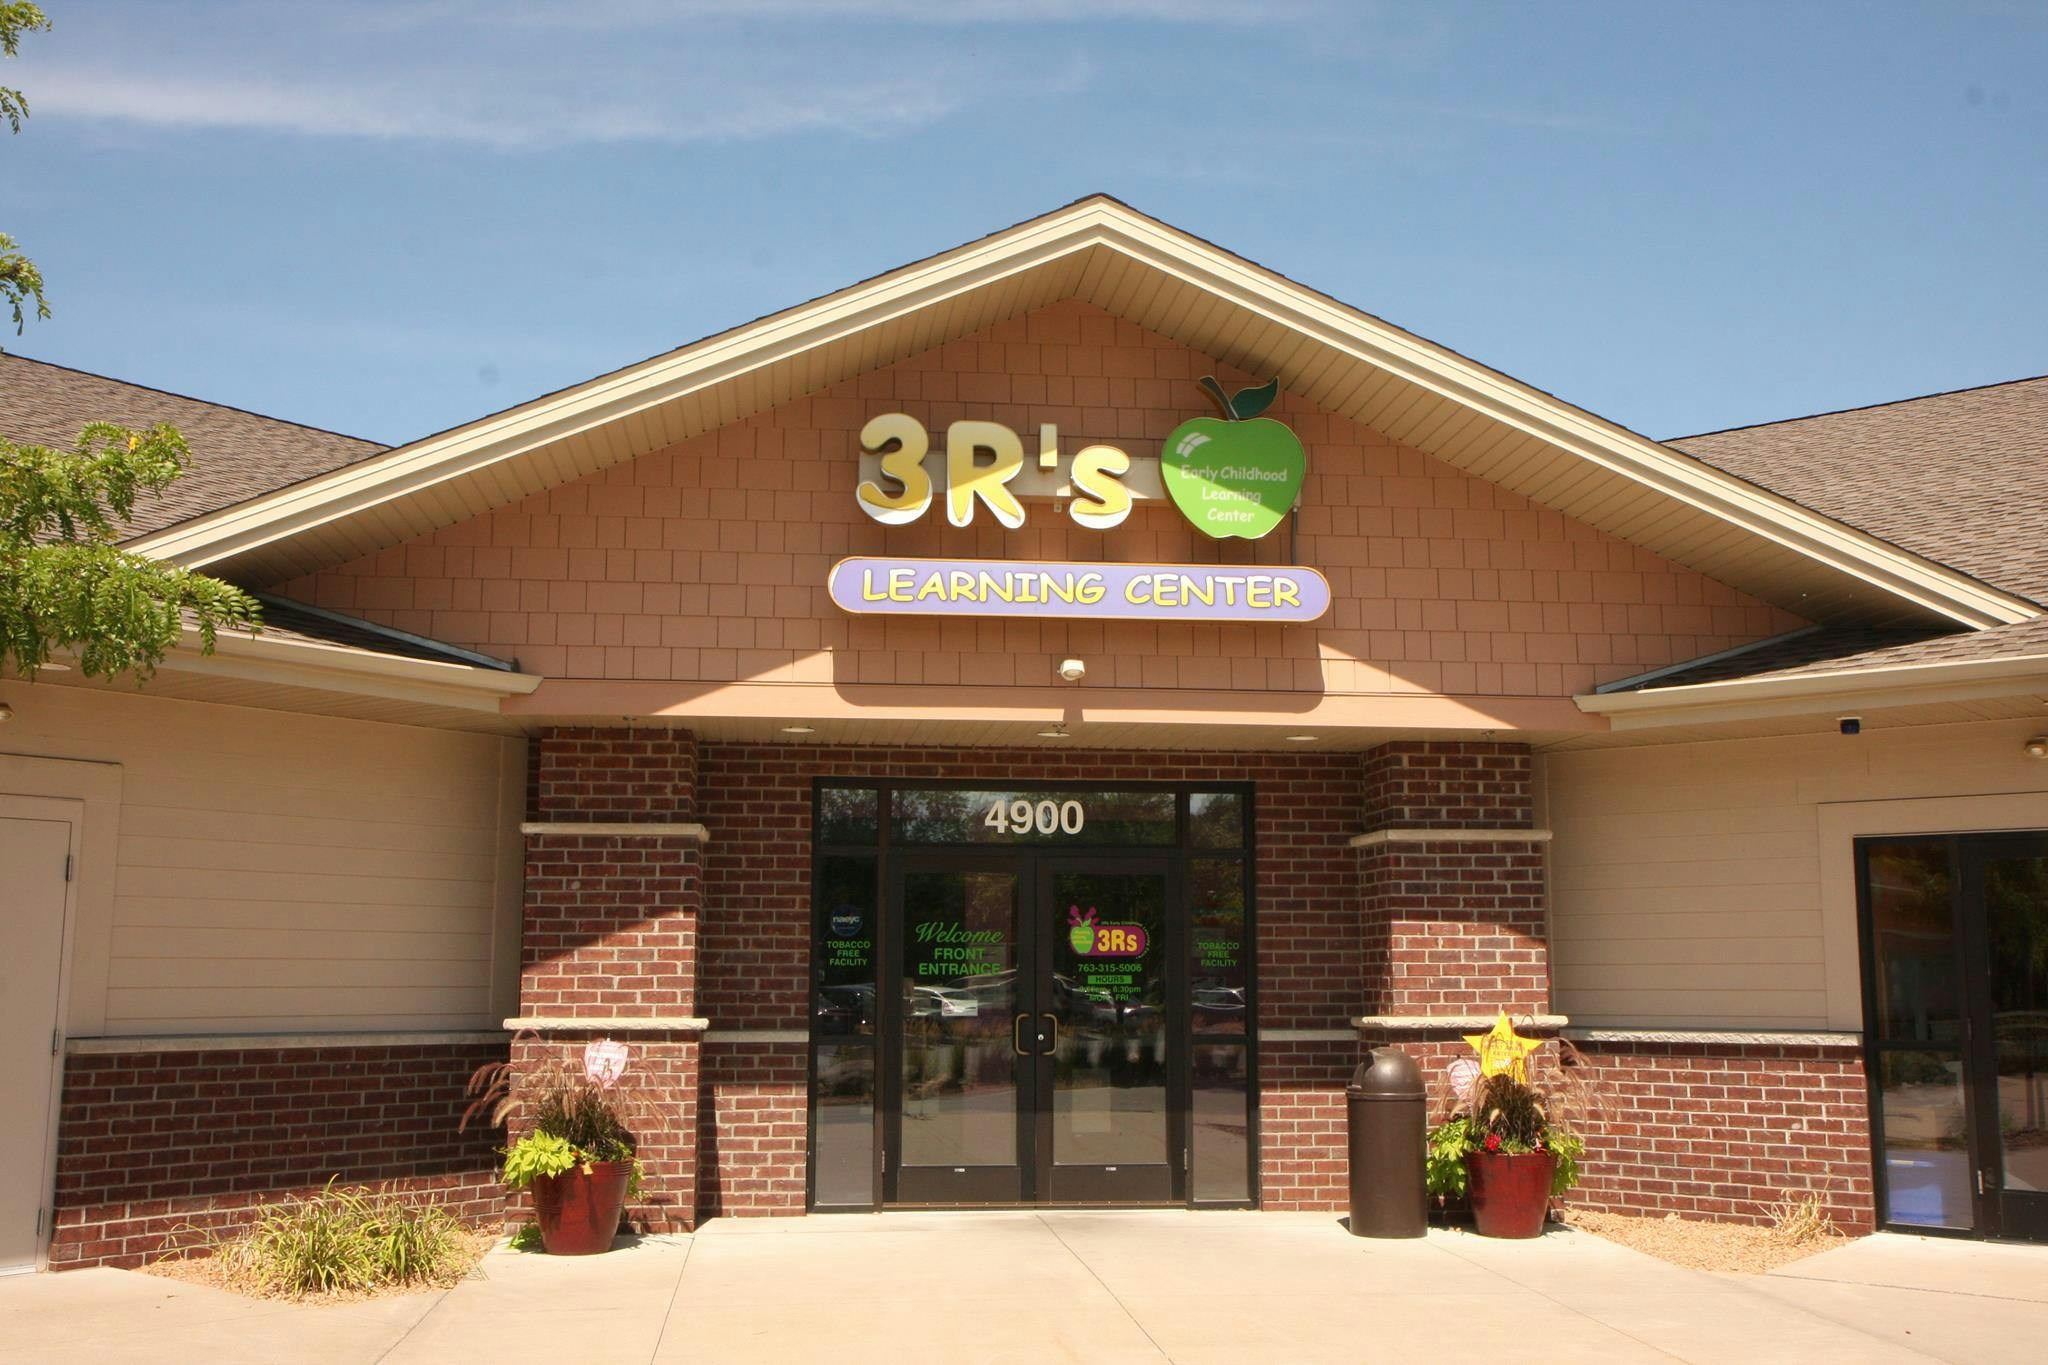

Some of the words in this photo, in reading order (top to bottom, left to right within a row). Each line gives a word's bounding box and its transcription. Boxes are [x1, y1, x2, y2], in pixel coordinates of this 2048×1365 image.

[1181, 464, 1218, 484] Early
[1220, 466, 1288, 482] Childhood
[1202, 486, 1261, 505] Learning
[1207, 508, 1255, 522] Center
[862, 568, 1106, 604] LEARNING
[1124, 573, 1301, 608] CENTER
[984, 799, 1084, 835] 4900
[915, 921, 1005, 943] Welcome
[827, 940, 871, 949] TOBACCO
[1097, 929, 1138, 952] 3Rs
[1198, 942, 1240, 950] TOBACCO
[836, 949, 860, 957] FREE
[934, 947, 986, 960] FRONT
[1207, 950, 1230, 958] FREE
[829, 958, 868, 966] FACILITY
[1077, 963, 1142, 972] 763-315-5006
[1200, 959, 1238, 967] FACILITY
[918, 962, 1002, 976] ENTRANCE
[1095, 976, 1125, 984] HOURS
